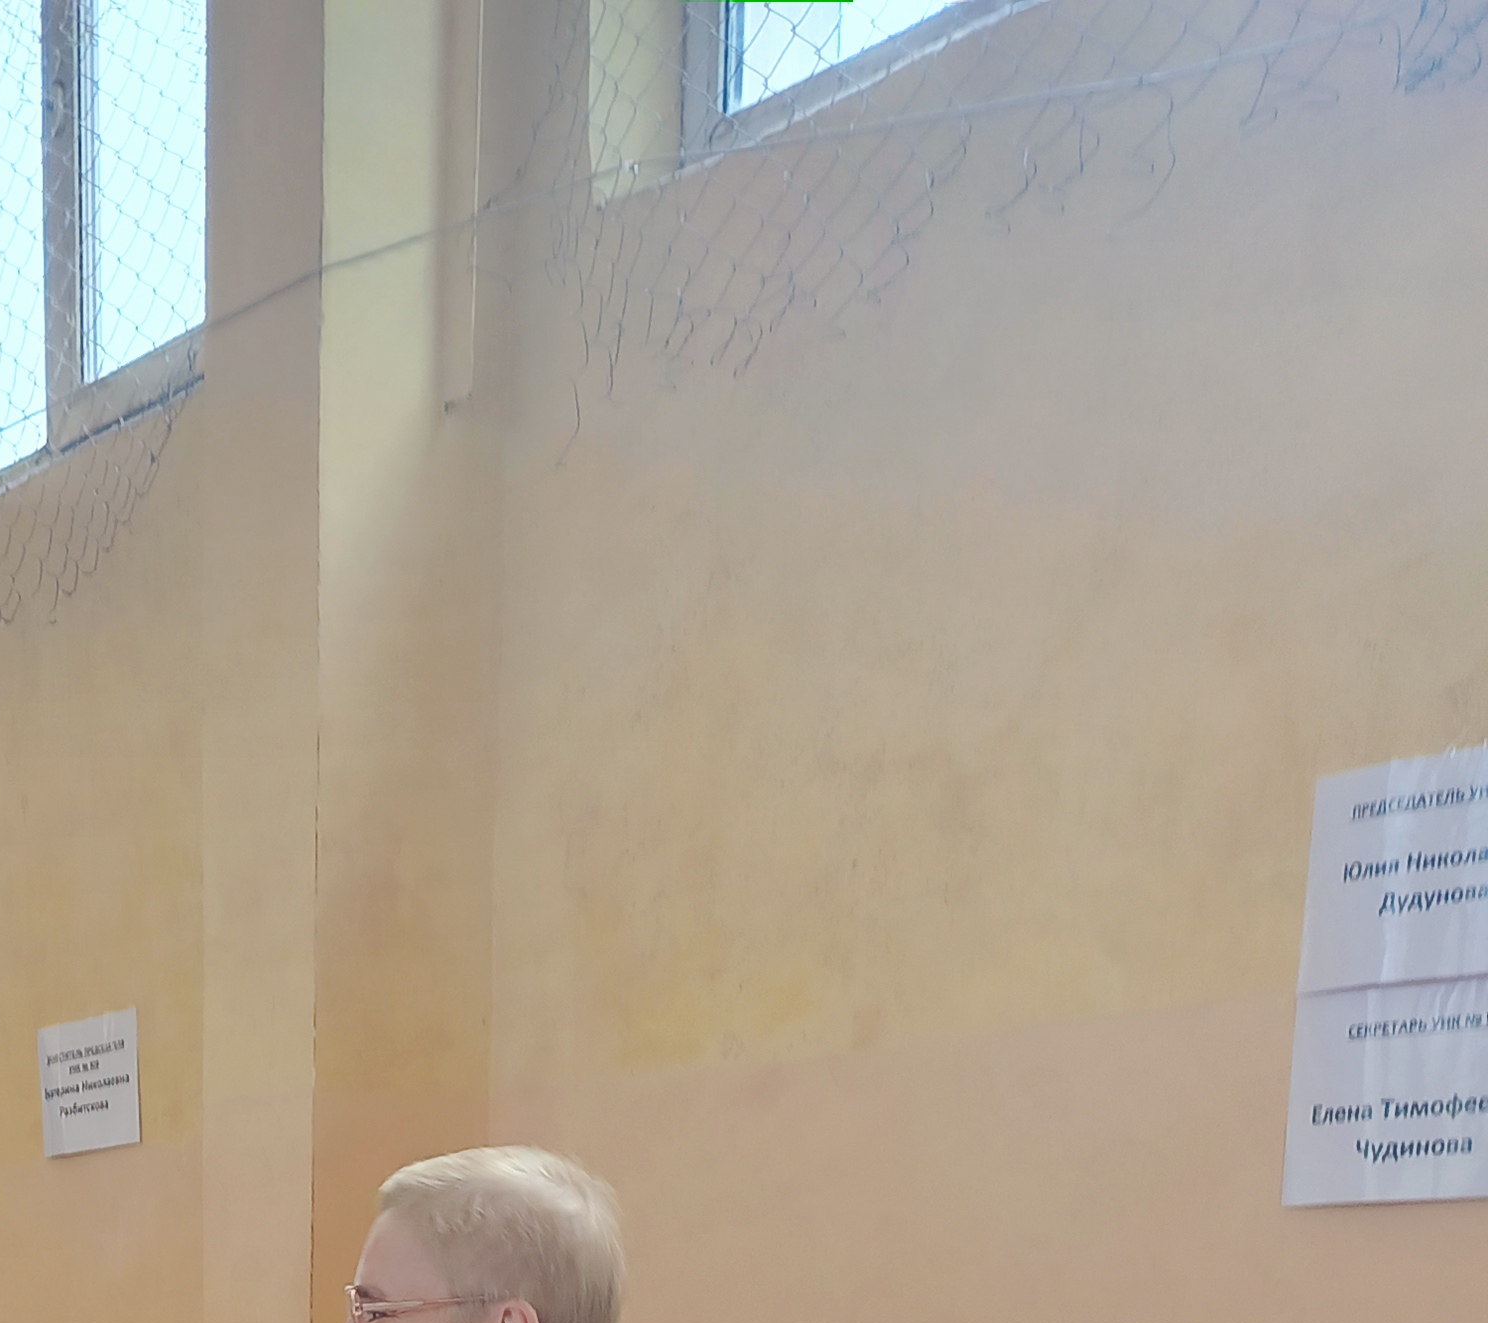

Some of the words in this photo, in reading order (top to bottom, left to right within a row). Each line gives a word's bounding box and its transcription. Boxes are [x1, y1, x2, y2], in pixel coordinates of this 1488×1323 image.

[1343, 858, 1400, 884] Юлия
[1348, 1018, 1427, 1040] СЕКРЕТАРЬ
[1312, 1103, 1373, 1126] Елена
[1356, 1136, 1473, 1164] Чудинова
